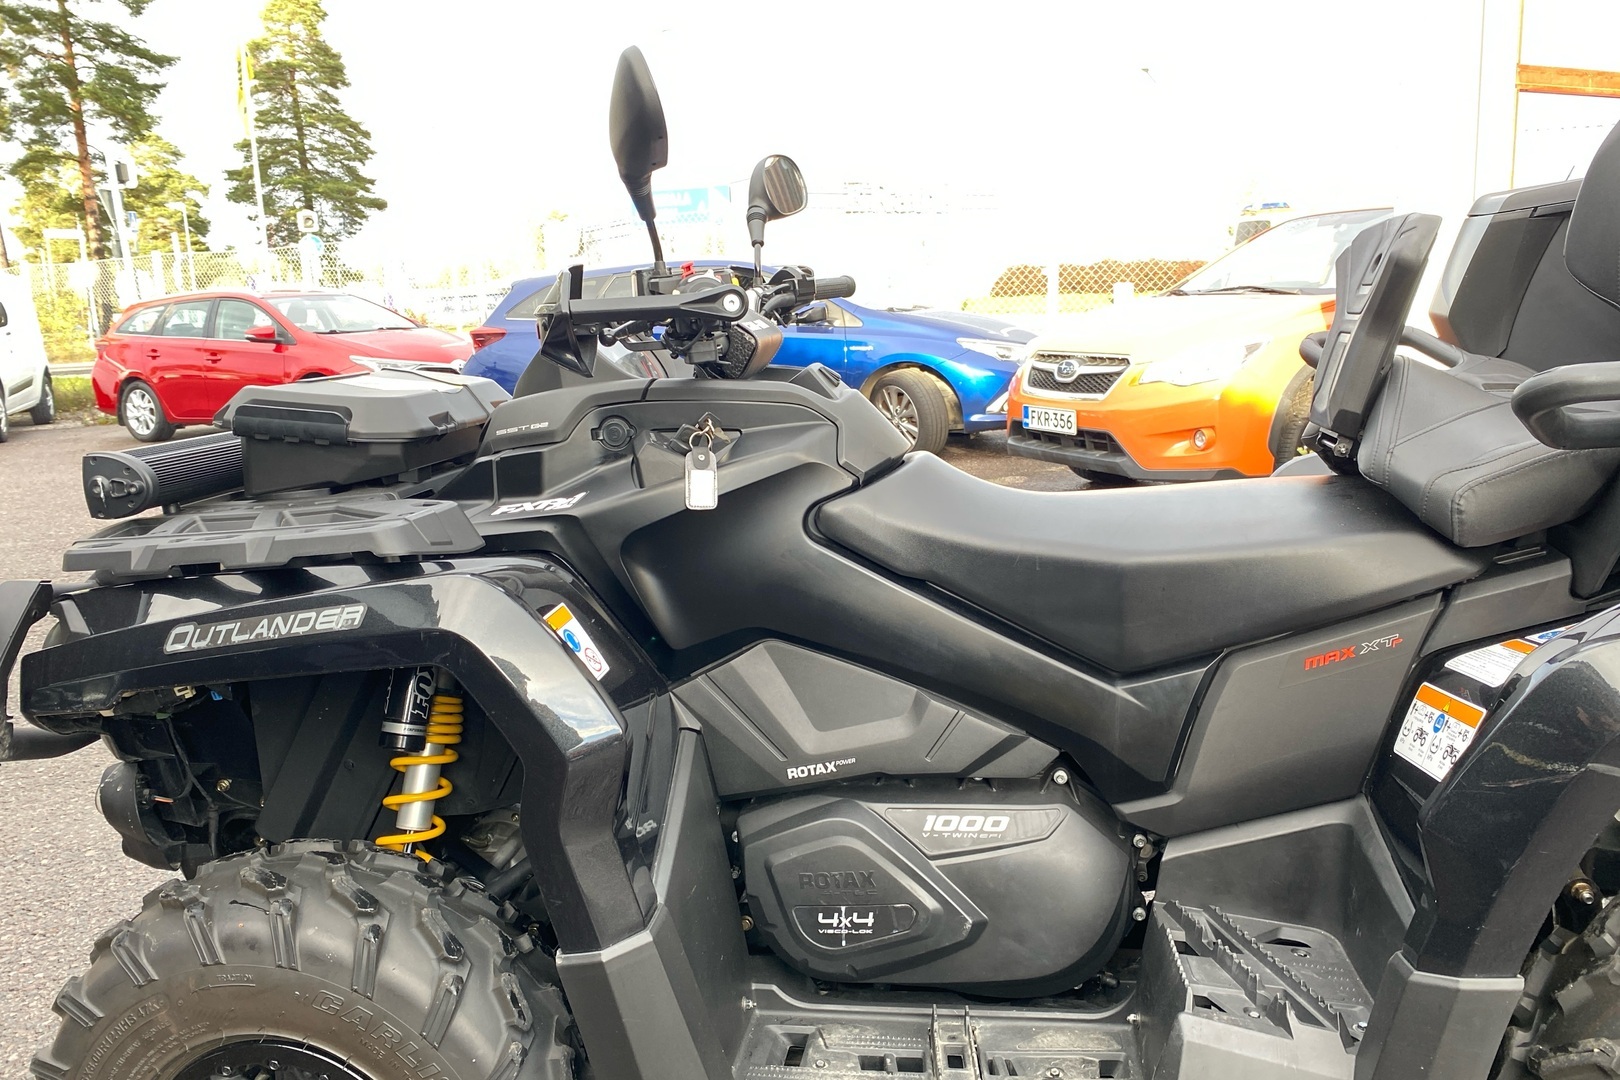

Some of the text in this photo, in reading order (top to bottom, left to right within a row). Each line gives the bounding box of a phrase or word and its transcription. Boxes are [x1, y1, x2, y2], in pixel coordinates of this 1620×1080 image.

[165, 604, 366, 653] OUTLANDER
[1303, 645, 1357, 671] MAX
[786, 757, 857, 780] ROTAX POWER
[922, 814, 1011, 832] 1000
[798, 869, 877, 890] ROTAX
